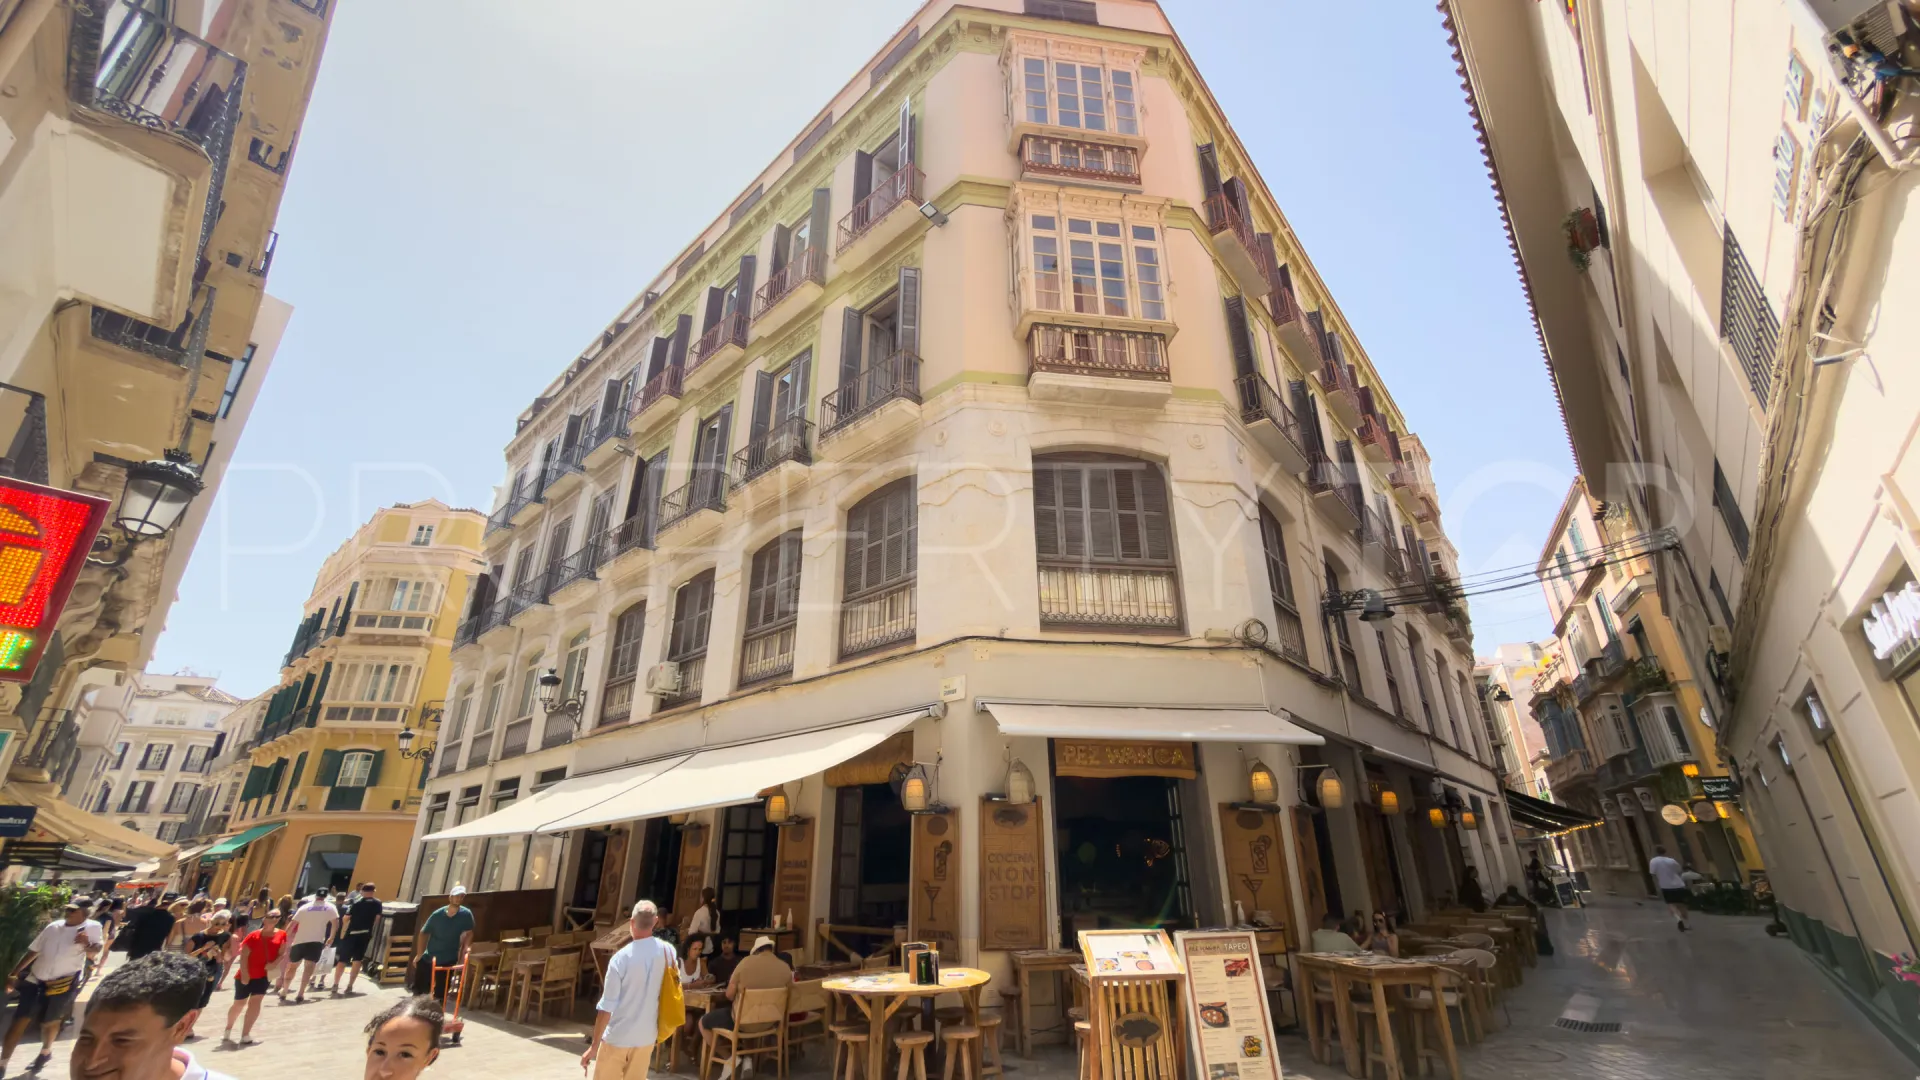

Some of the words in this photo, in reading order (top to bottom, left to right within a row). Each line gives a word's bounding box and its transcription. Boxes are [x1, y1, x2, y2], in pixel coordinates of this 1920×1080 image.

[1063, 744, 1101, 766] PEZ
[988, 867, 1035, 881] NON
[988, 884, 1036, 901] STOP
[1223, 942, 1248, 951] TAPEO
